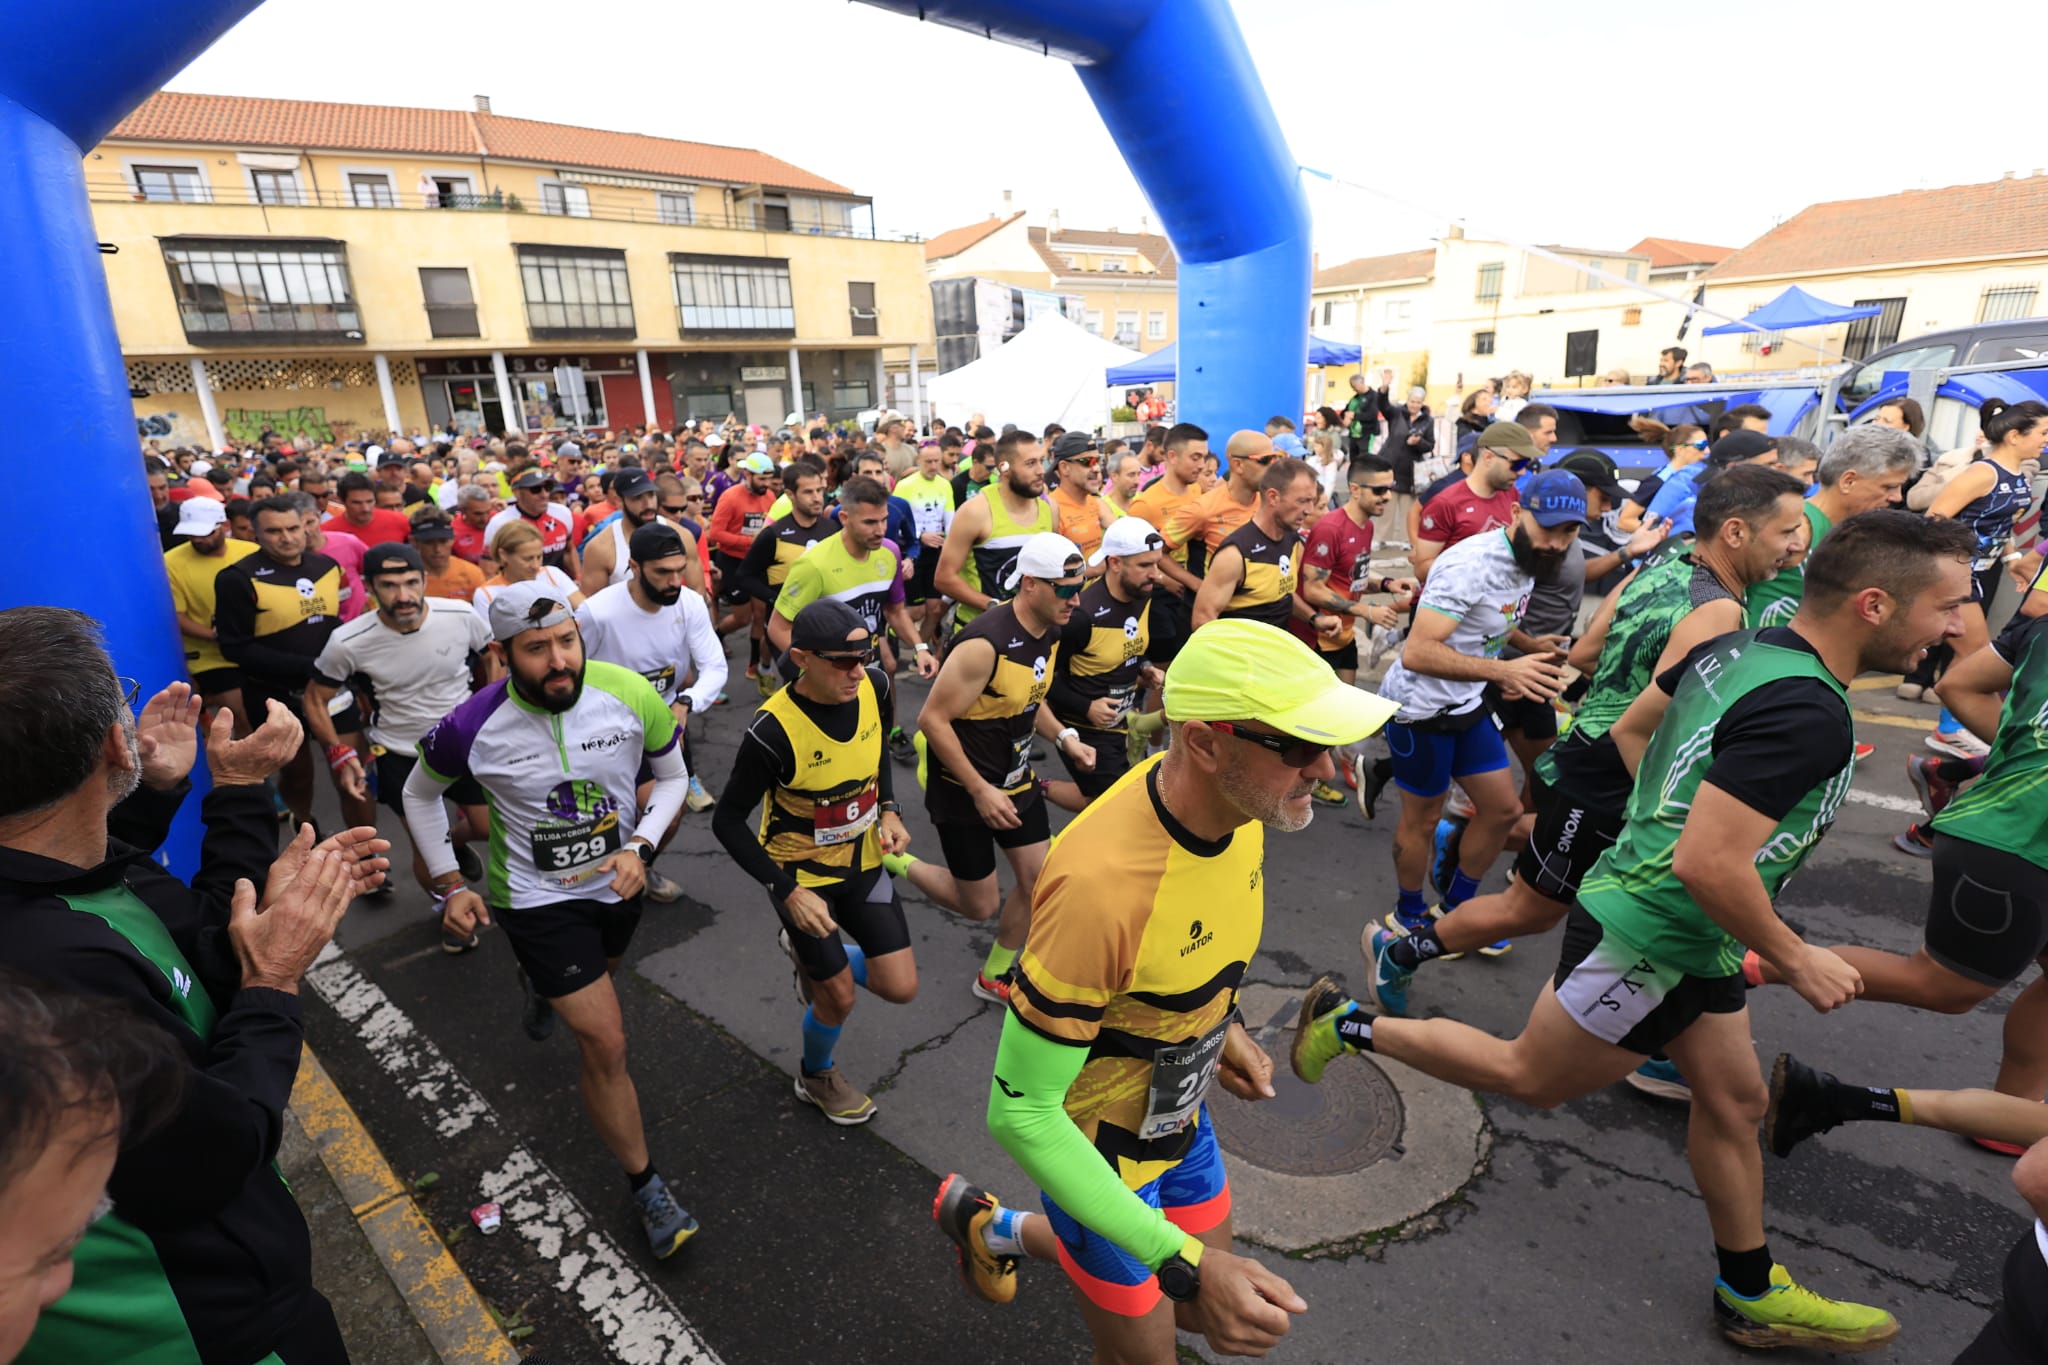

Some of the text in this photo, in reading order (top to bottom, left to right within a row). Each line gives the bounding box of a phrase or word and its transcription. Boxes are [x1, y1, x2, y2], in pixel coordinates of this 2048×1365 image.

[808, 758, 832, 768] VIATOR
[846, 801, 860, 820] 6
[544, 832, 561, 841] LIGA
[567, 826, 591, 838] CROSS
[1557, 808, 1585, 853] WONG
[552, 836, 606, 867] 329
[1180, 932, 1213, 957] VIATOR
[1174, 1052, 1196, 1066] LIGA
[1201, 1030, 1225, 1054] CROSS
